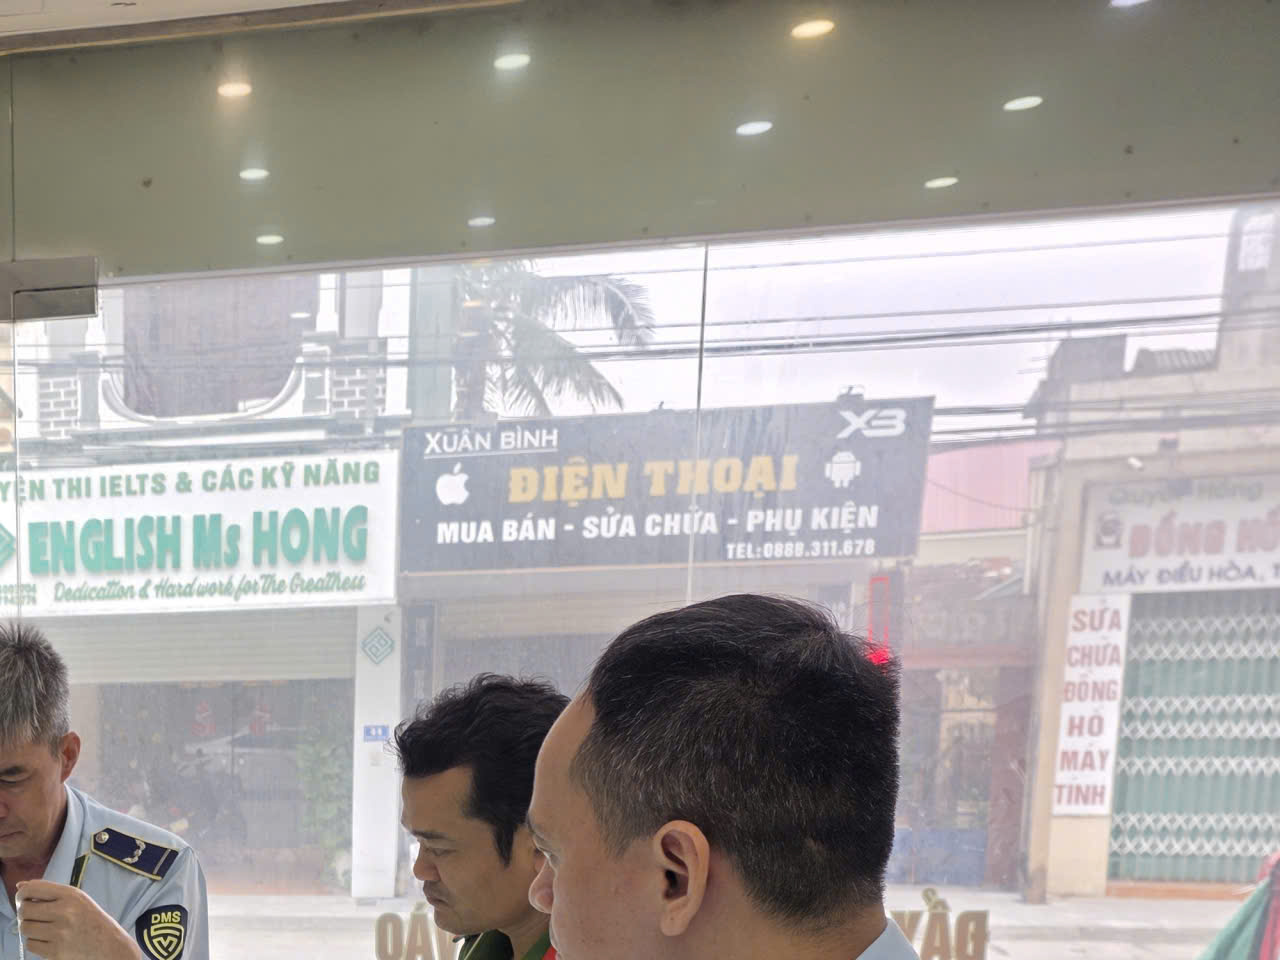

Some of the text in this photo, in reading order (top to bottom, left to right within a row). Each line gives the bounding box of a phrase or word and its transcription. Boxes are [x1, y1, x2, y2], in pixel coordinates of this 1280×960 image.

[424, 427, 559, 456] XUÂN BÌNH
[837, 407, 907, 440] X3
[53, 475, 92, 501] THI
[99, 472, 165, 498] IELTS
[175, 470, 193, 494] &
[201, 463, 255, 491] CÁC
[261, 460, 296, 489] KỸ
[303, 459, 381, 487] NĂNG
[508, 454, 798, 508] ĐIỆN THOẠI
[27, 504, 370, 576] ENGLISH Ms HONG
[436, 521, 494, 545] MUA
[502, 511, 556, 542] BÁN
[581, 506, 638, 539] SỬA
[644, 503, 719, 537] CHỮA
[746, 509, 803, 539] PHỤ
[810, 500, 879, 535] KIỆN
[1102, 564, 1150, 587] MÁY
[150, 911, 181, 924] DMS
